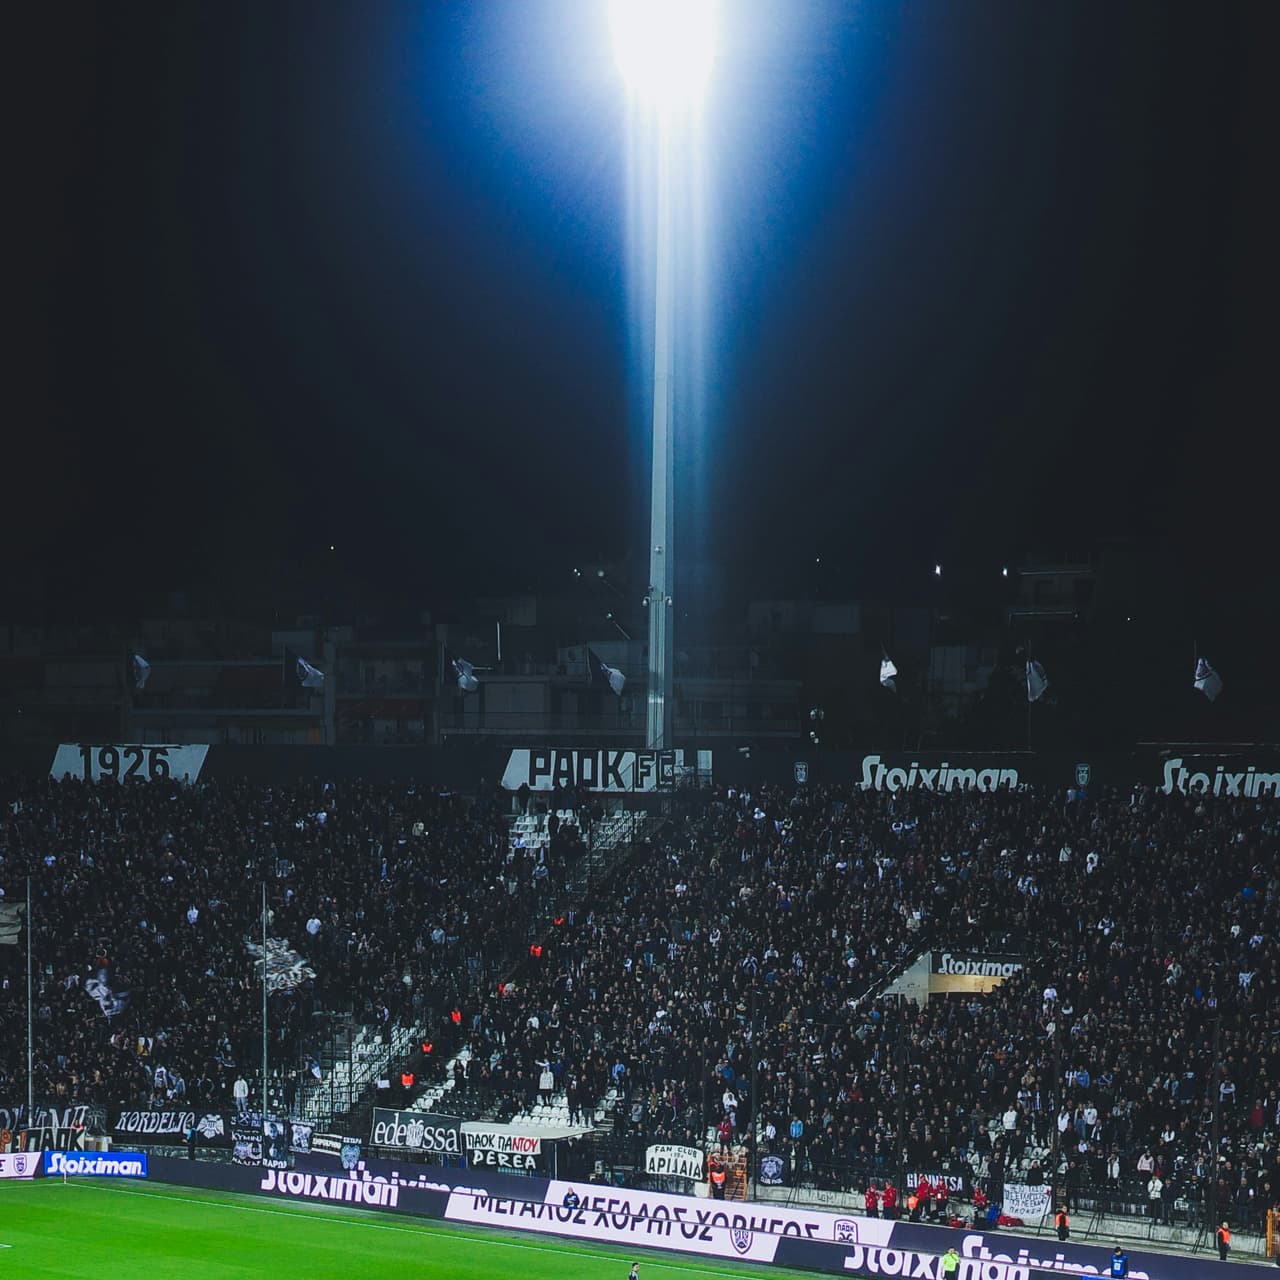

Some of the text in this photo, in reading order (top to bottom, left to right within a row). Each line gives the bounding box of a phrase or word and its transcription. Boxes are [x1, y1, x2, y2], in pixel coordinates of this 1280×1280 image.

[81, 746, 170, 784] 1926
[529, 750, 625, 787] PAOK
[855, 755, 1019, 793] Stoiximan
[466, 1132, 538, 1153] ΠΑΟΚ ΠΑΝΤΟΥ
[655, 1146, 672, 1154] FAN
[678, 1147, 697, 1158] CLUB
[47, 1153, 145, 1176] Stoiximan
[472, 1151, 536, 1169] PEREA
